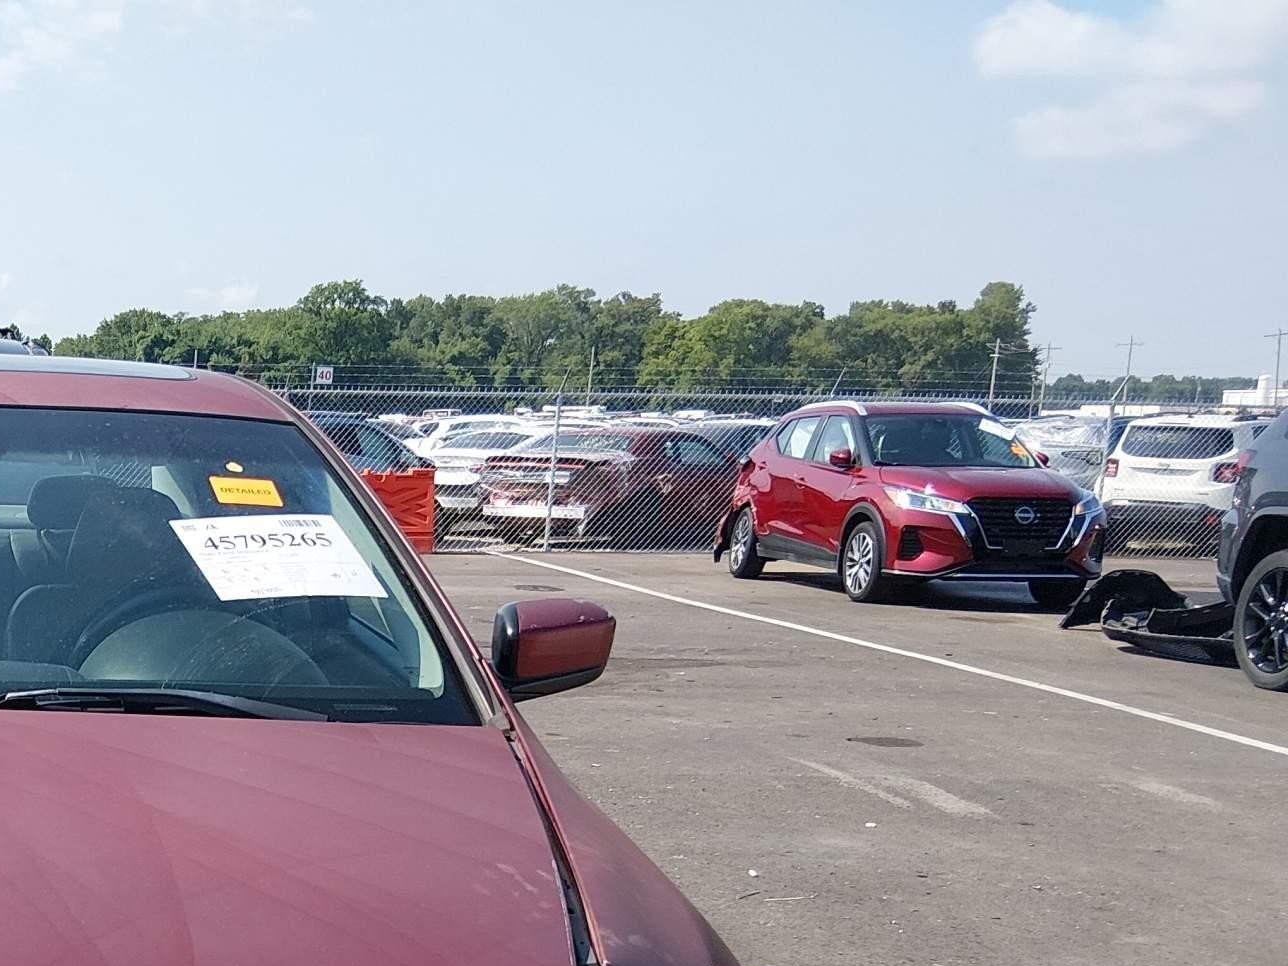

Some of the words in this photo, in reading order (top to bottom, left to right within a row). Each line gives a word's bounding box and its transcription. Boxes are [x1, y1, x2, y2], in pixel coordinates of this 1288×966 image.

[318, 370, 332, 381] 40
[219, 487, 272, 496] DETAILED
[203, 532, 333, 551] 45795265
